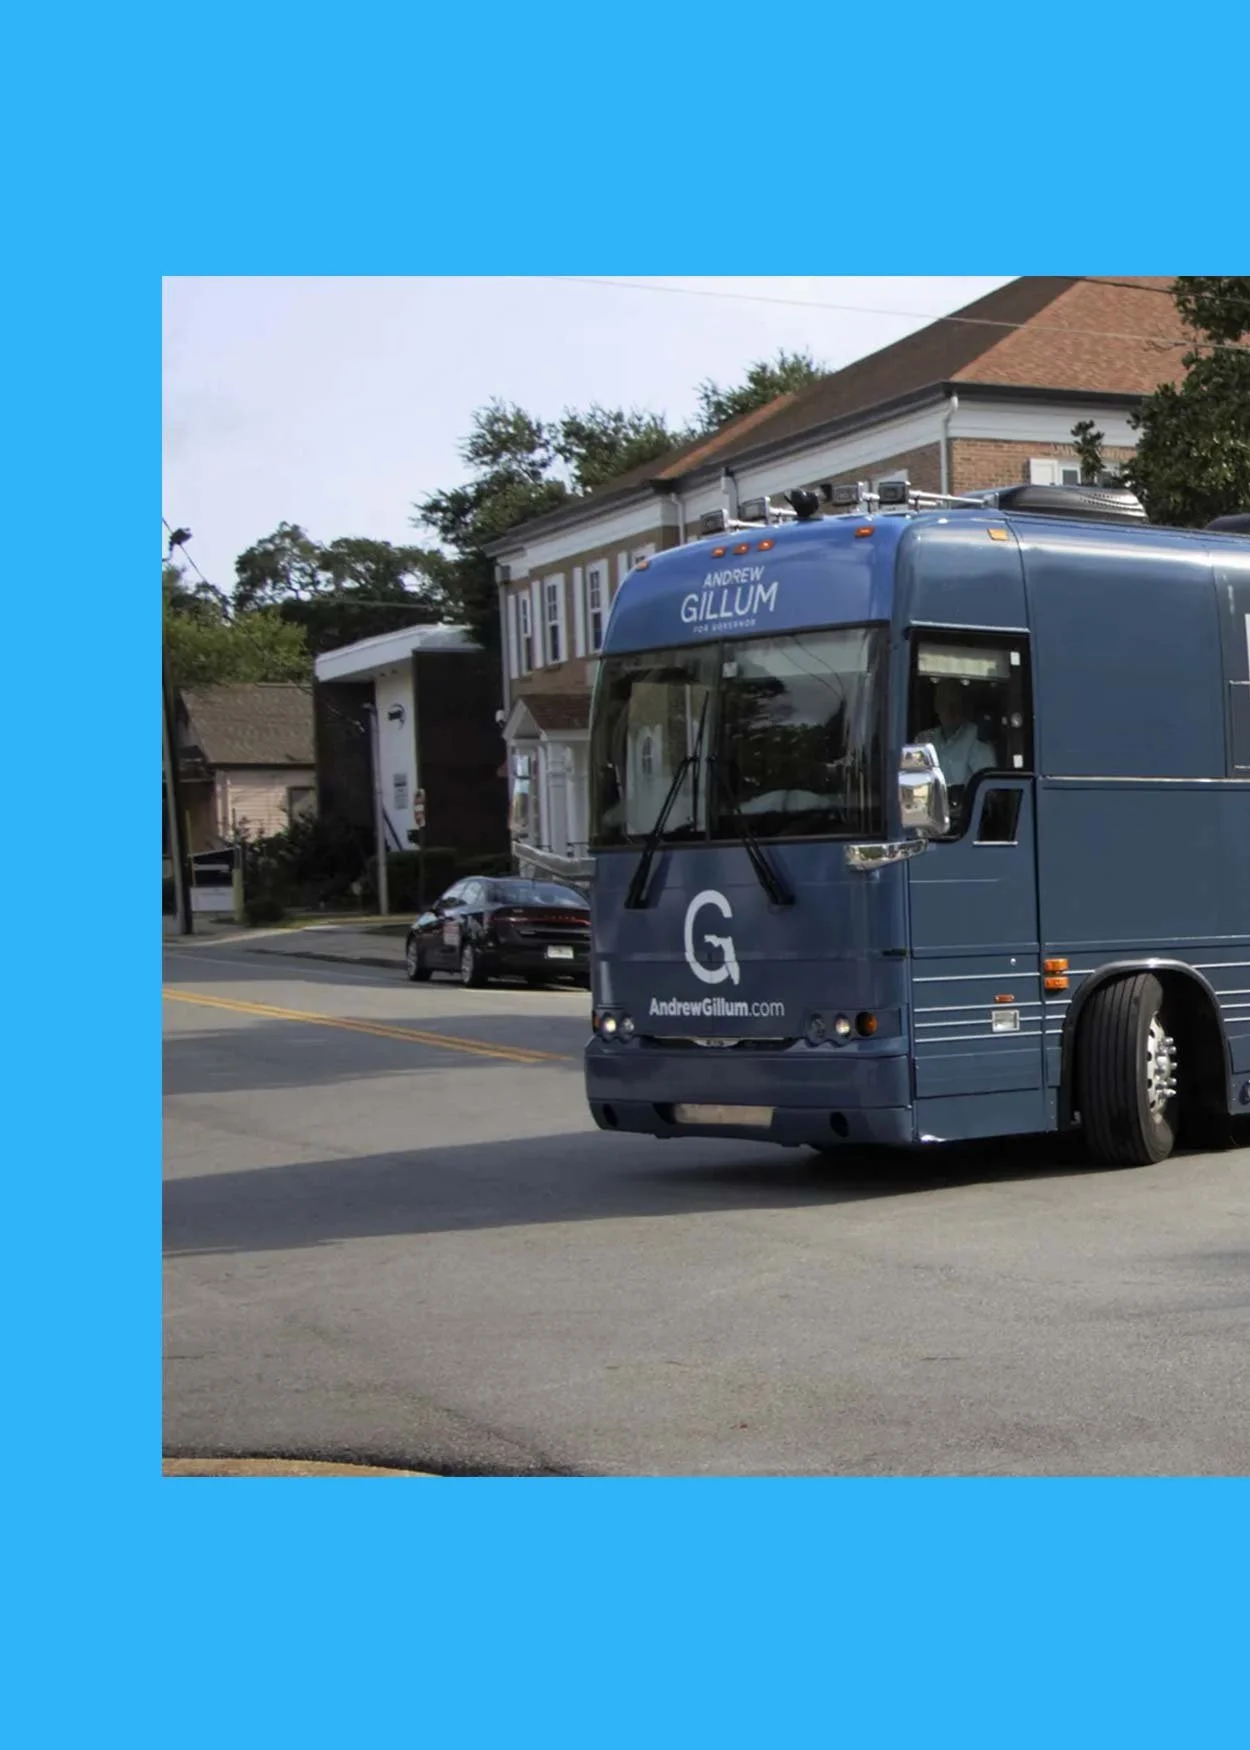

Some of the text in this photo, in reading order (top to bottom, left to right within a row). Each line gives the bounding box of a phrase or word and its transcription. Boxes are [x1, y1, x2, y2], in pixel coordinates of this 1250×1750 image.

[703, 566, 765, 588] ANDREW
[681, 581, 778, 623] GILLUM
[684, 890, 741, 985] G
[649, 997, 785, 1018] AndrewGillum.com
